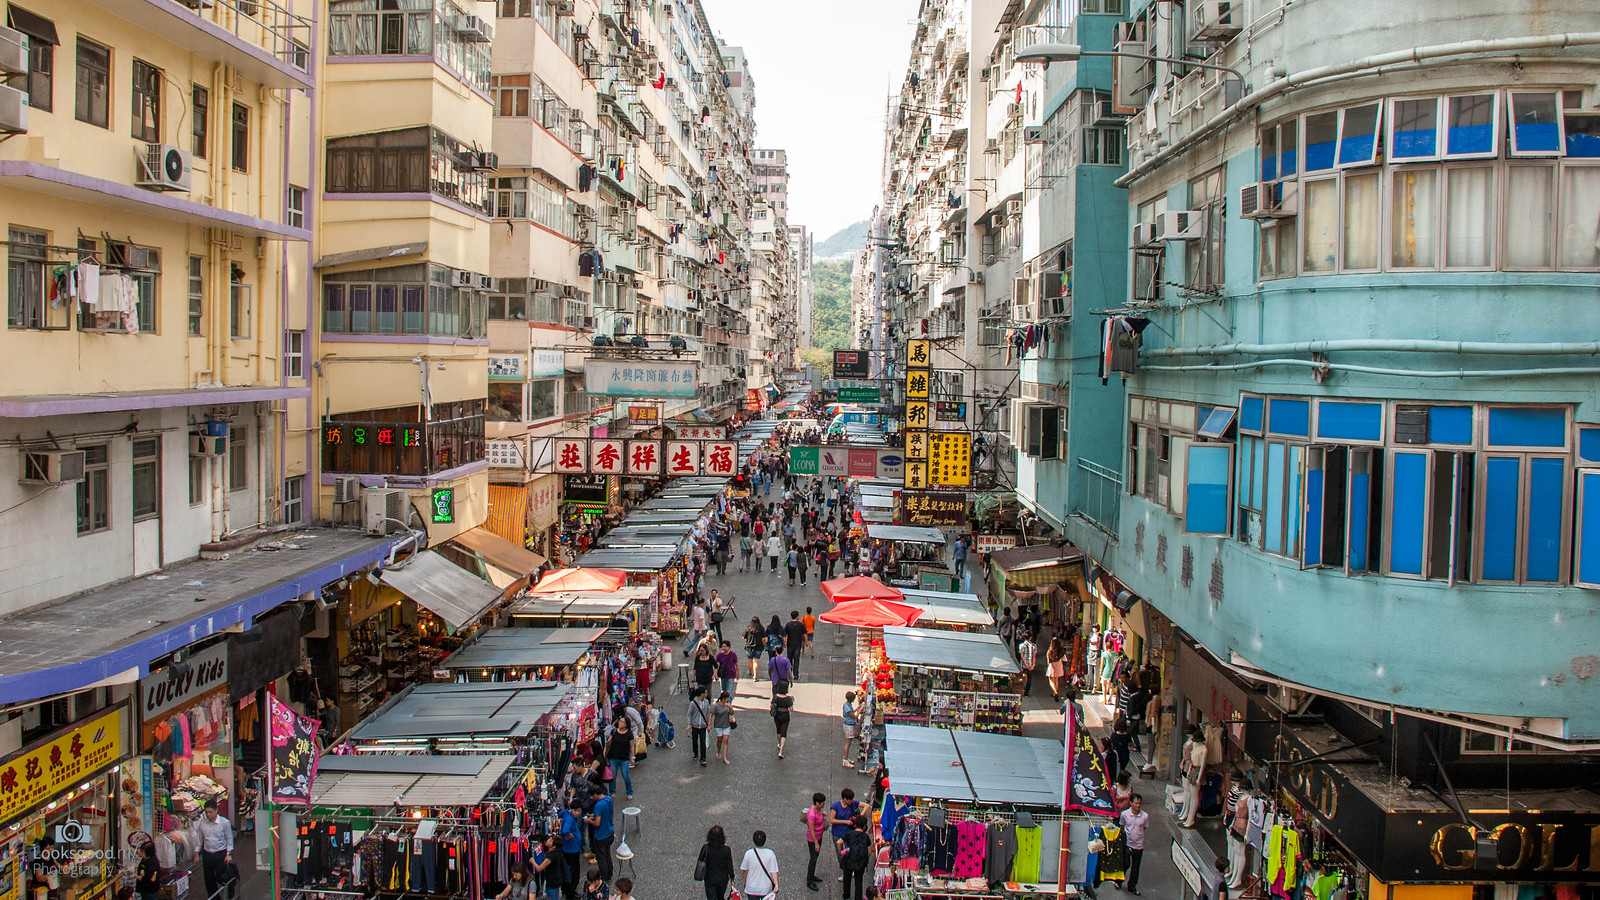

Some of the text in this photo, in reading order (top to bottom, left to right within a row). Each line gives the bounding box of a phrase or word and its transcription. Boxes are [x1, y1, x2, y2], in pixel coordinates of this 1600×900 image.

[147, 656, 225, 711] LUCKY Kids
[1, 733, 85, 794] 陳記魚蛋
